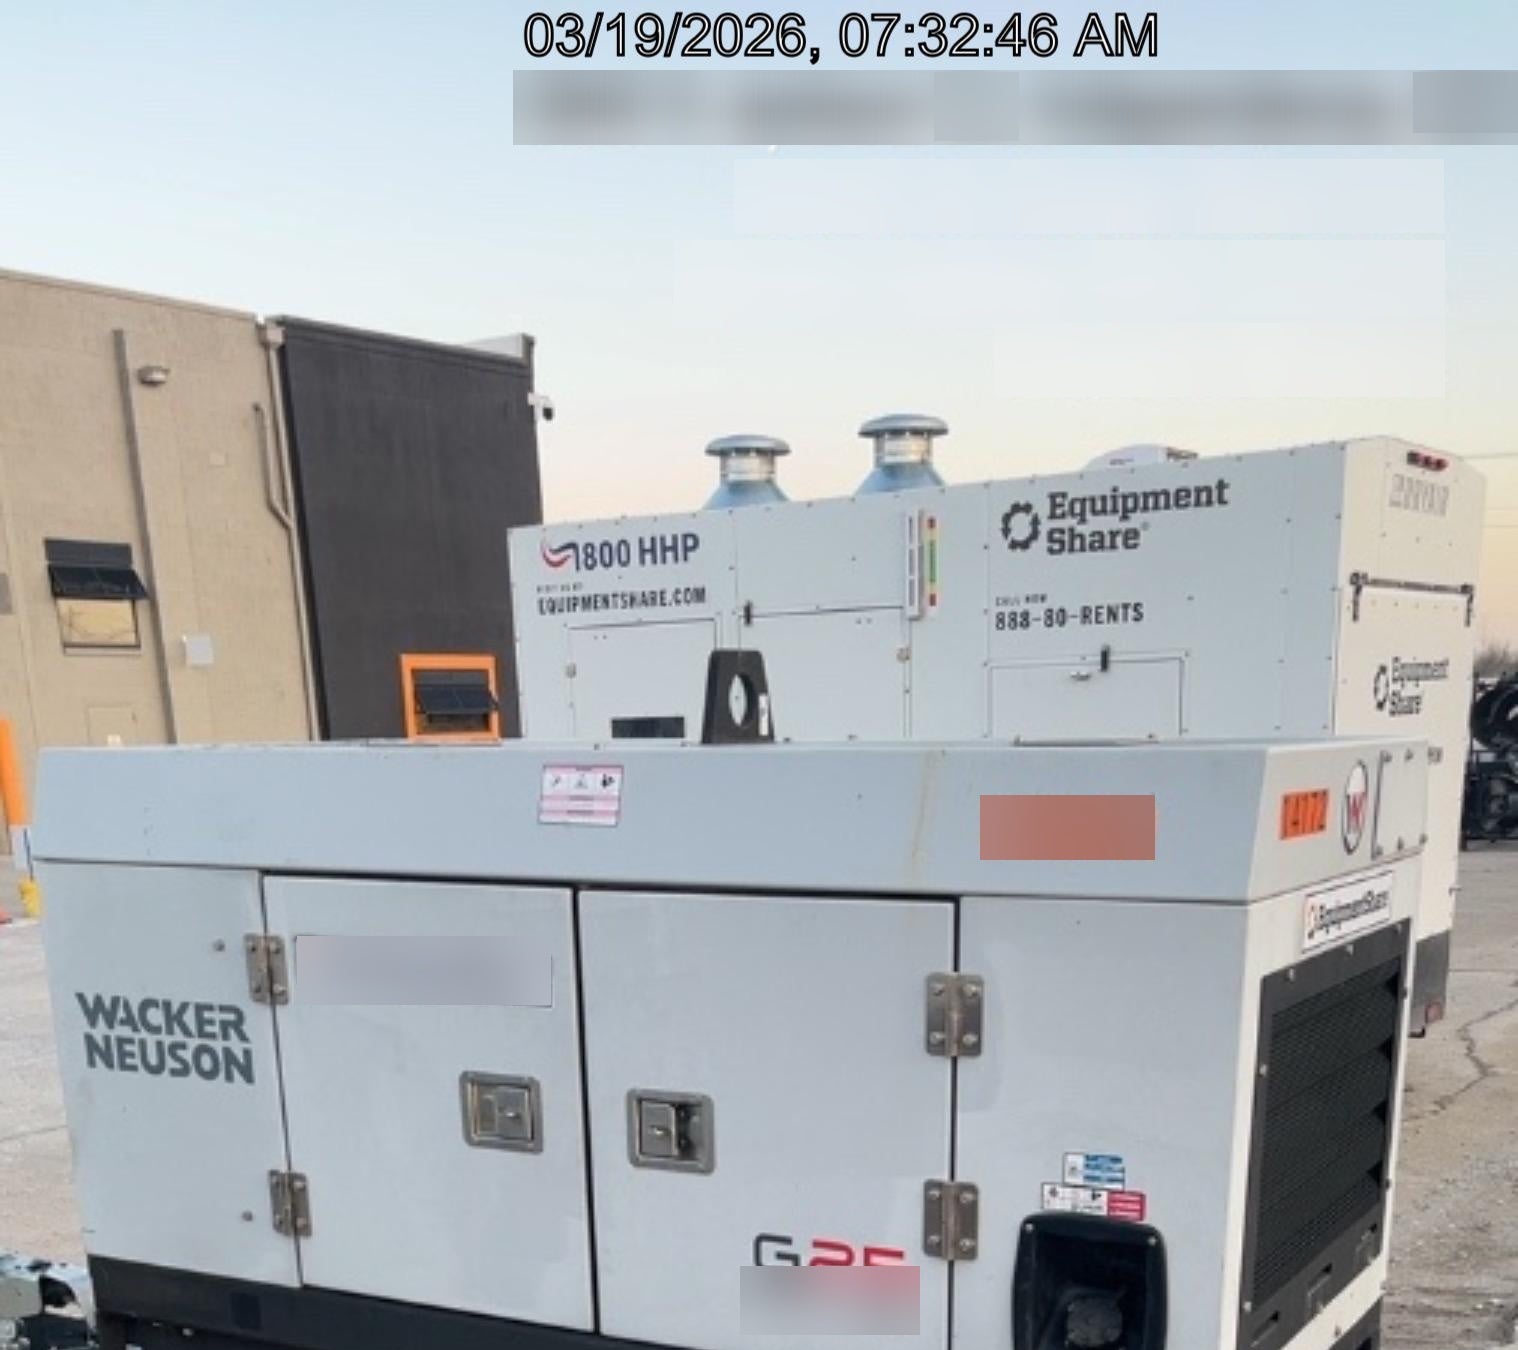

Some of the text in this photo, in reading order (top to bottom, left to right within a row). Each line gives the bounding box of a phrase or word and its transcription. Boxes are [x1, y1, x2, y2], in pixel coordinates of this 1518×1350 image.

[1047, 479, 1230, 525] Equipment
[638, 533, 699, 566] HHP
[1046, 526, 1141, 556] Share
[995, 602, 1144, 631] 888-80-RENTS
[75, 992, 249, 1043] WACKER
[84, 1032, 255, 1084] NEUSON
